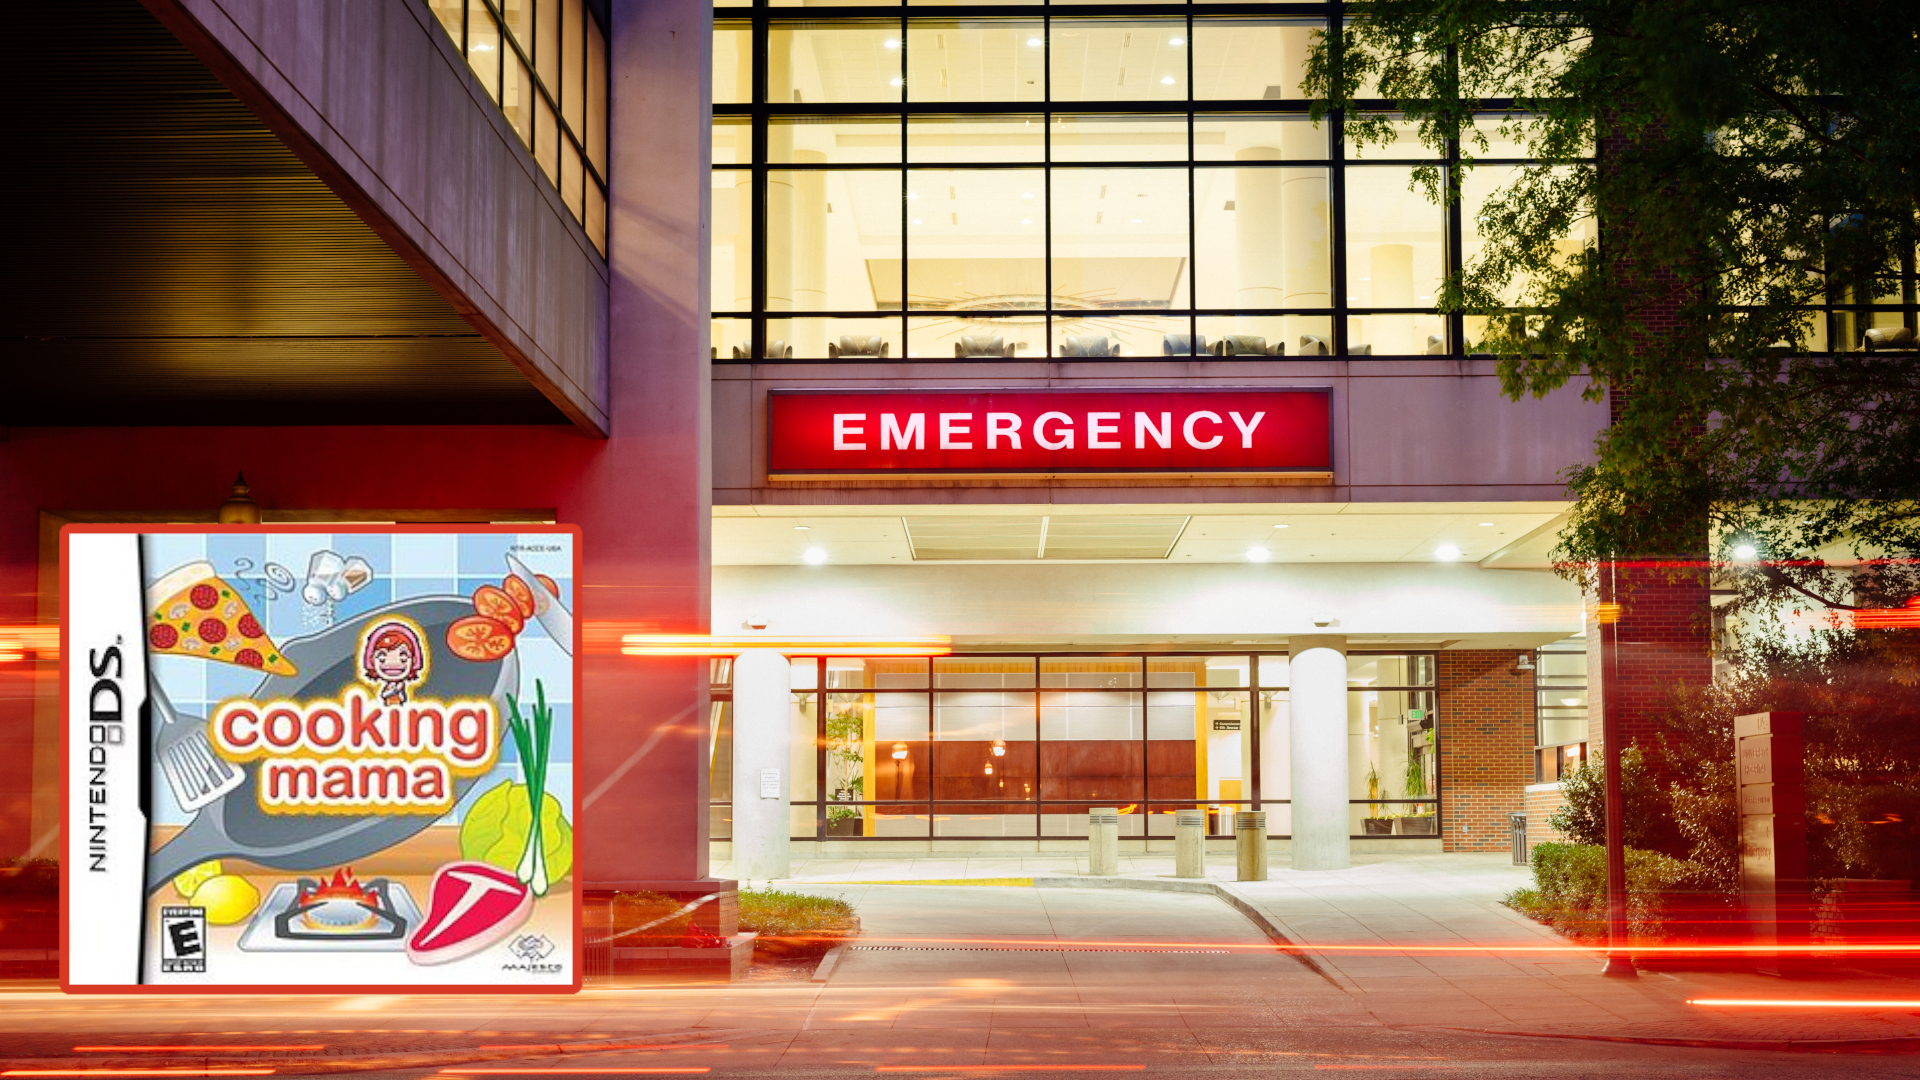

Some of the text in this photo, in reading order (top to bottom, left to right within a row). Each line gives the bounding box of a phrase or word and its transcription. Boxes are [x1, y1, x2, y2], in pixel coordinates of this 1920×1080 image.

[833, 410, 1267, 451] EMERGENCY
[222, 695, 488, 761] cooking
[1411, 710, 1422, 719] EXIT
[89, 645, 123, 872] NINTENDO DS
[270, 765, 444, 800] mama
[1746, 844, 1772, 861] Emergency
[168, 920, 201, 957] E
